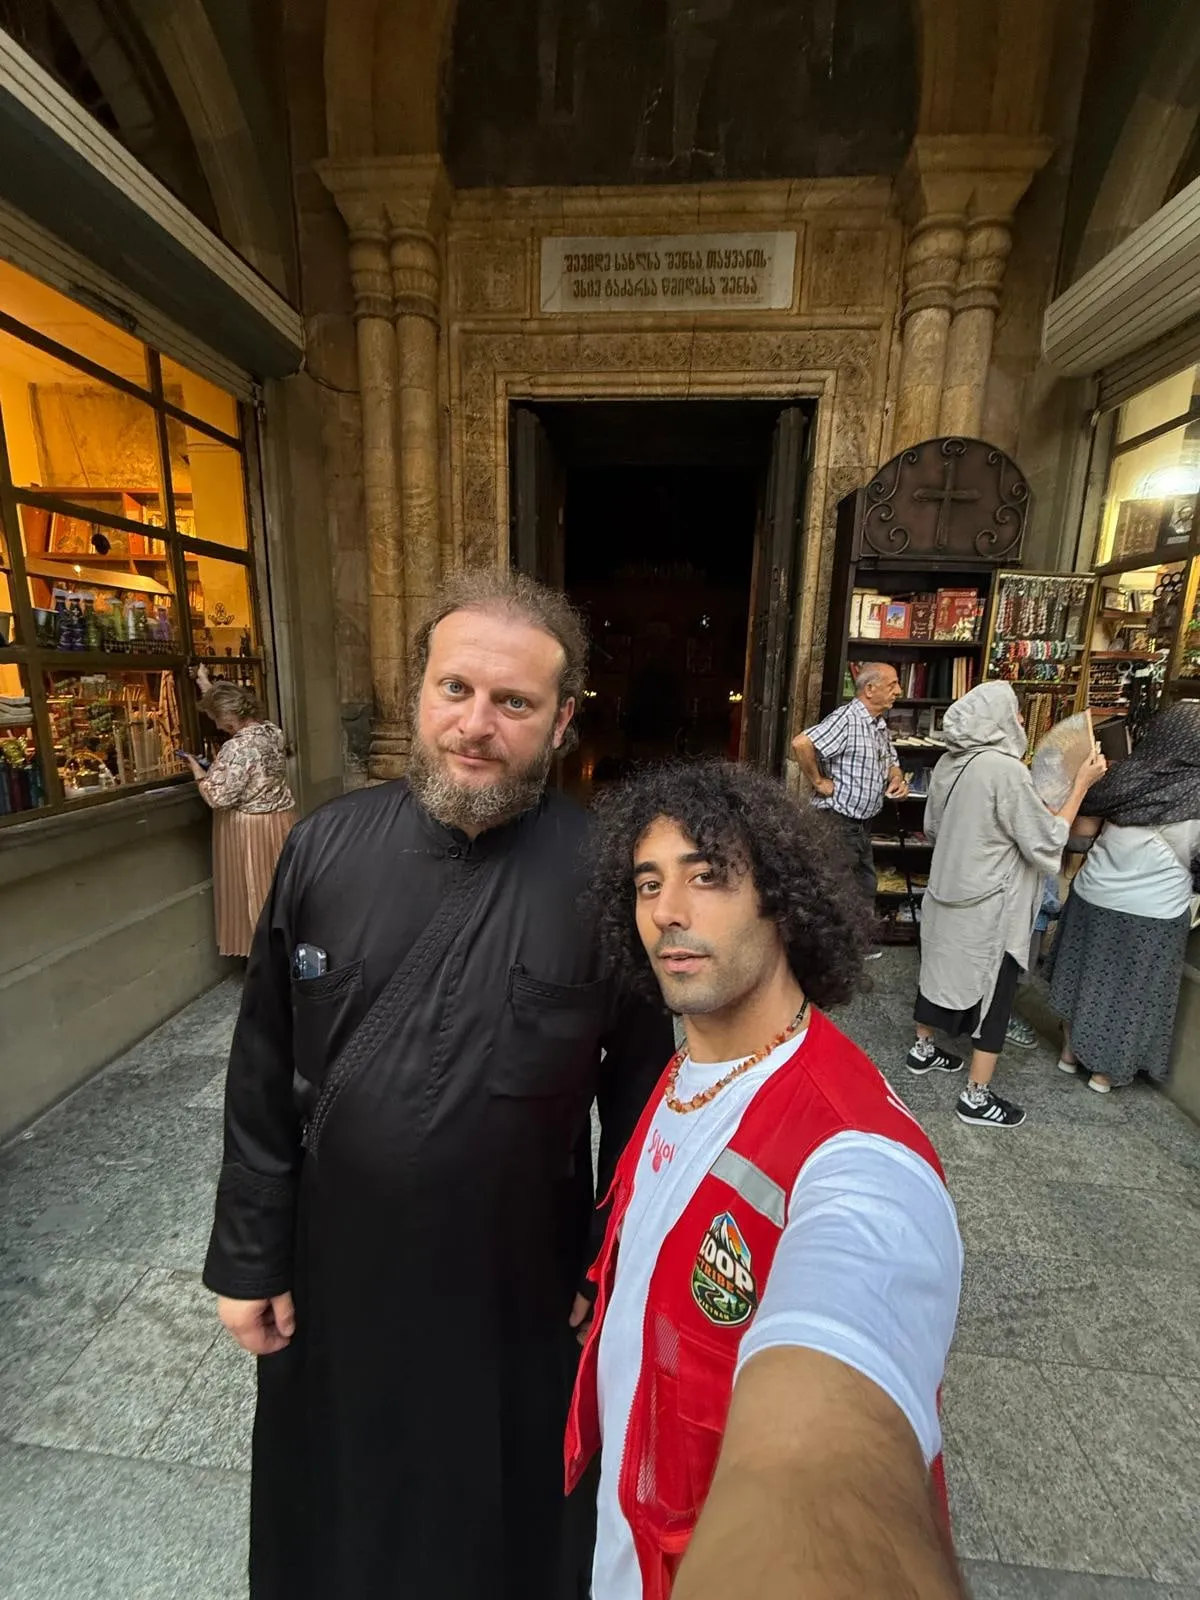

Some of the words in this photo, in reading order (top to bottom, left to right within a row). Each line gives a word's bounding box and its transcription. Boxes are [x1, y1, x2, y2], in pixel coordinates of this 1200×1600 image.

[615, 252, 661, 271] სახლსა
[664, 251, 702, 270] შენსა
[605, 277, 658, 297] ტაძარსა
[661, 276, 716, 297] წმიდასა
[720, 276, 758, 295] შენსა
[699, 1232, 754, 1293] LOOP
[700, 1262, 735, 1294] TRIBE
[698, 1297, 730, 1321] VIETNAM
